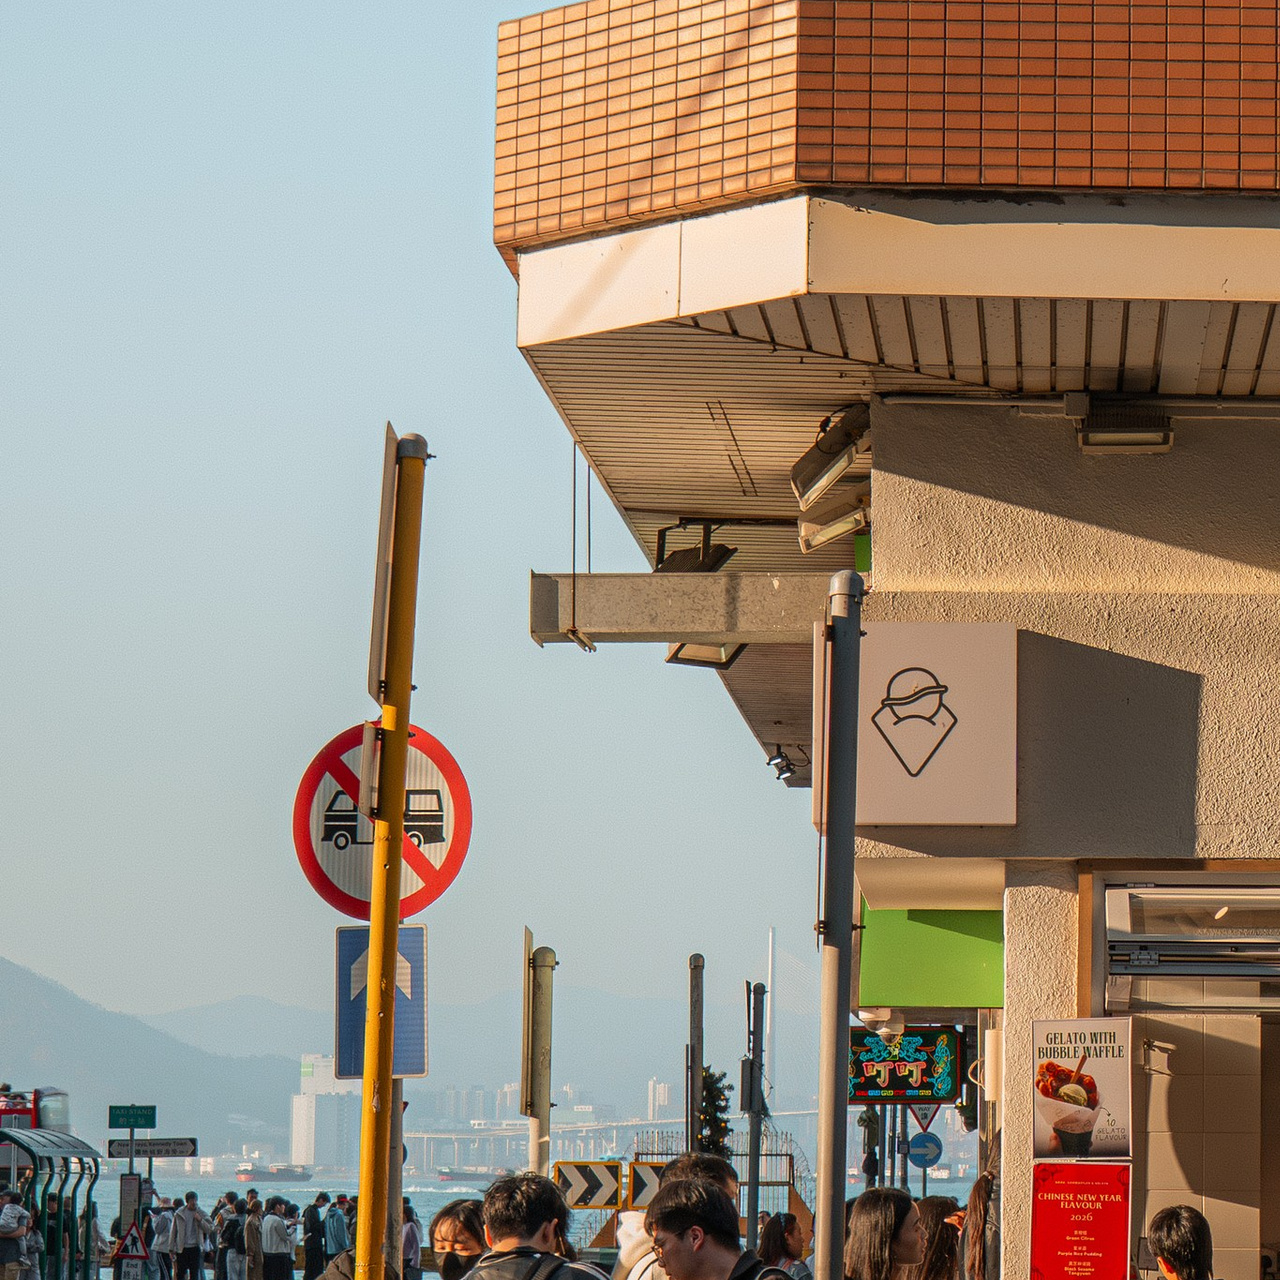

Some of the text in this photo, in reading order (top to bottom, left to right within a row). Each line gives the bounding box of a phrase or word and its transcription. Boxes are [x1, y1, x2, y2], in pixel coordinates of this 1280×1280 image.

[1046, 1031, 1116, 1045] GELATO WITH
[1038, 1045, 1124, 1059] BUBBLE WAFFLE
[862, 1061, 927, 1087] 叮叮
[1038, 1192, 1075, 1201] CHINESE
[1099, 1194, 1122, 1202] YEAR
[1060, 1201, 1102, 1209] FLAVOUR
[1070, 1212, 1093, 1221] 2026
